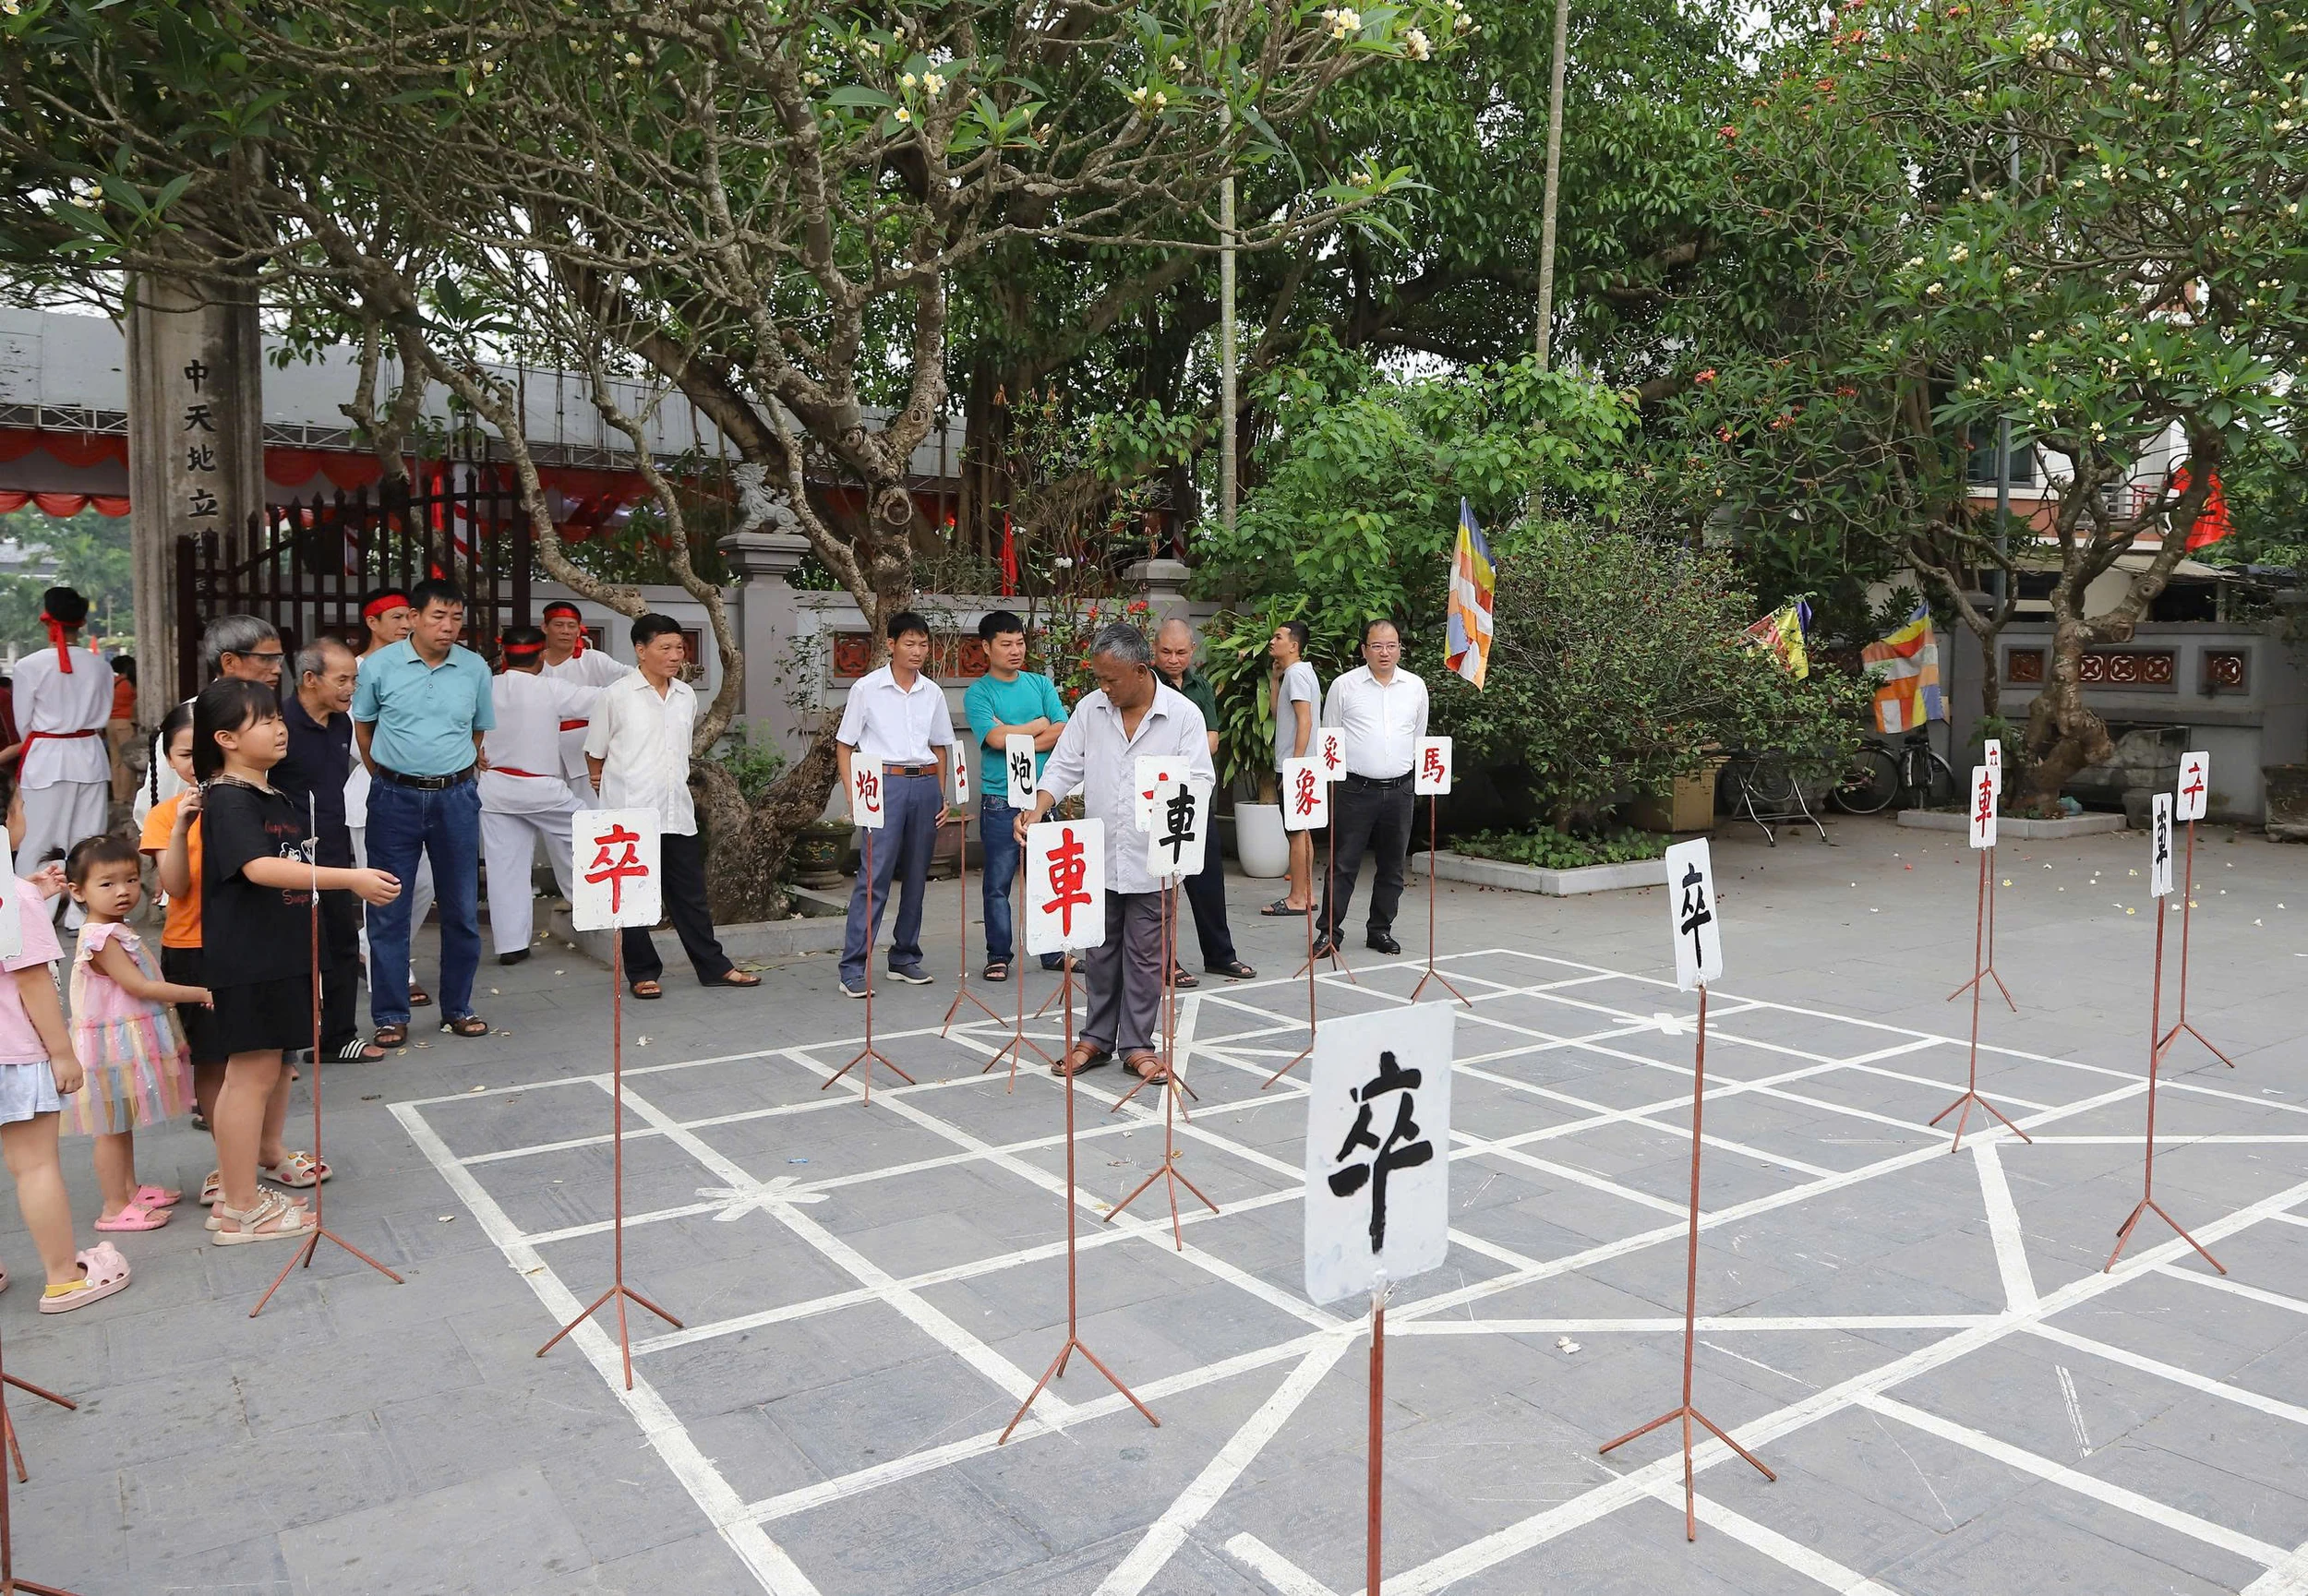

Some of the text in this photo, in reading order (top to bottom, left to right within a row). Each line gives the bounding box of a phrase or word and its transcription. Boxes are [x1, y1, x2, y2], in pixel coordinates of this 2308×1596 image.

[184, 359, 219, 595] 中天地立
[856, 769, 880, 812] 炮
[1010, 751, 1033, 796] 炮
[1422, 747, 1445, 784] 馬
[1976, 770, 1992, 838] 車
[1159, 783, 1196, 865] 車
[2156, 798, 2168, 884] 車
[584, 823, 650, 915] 卒
[1041, 827, 1092, 937] 車
[1680, 862, 1712, 969] 卒
[1328, 1050, 1434, 1254] 卒
